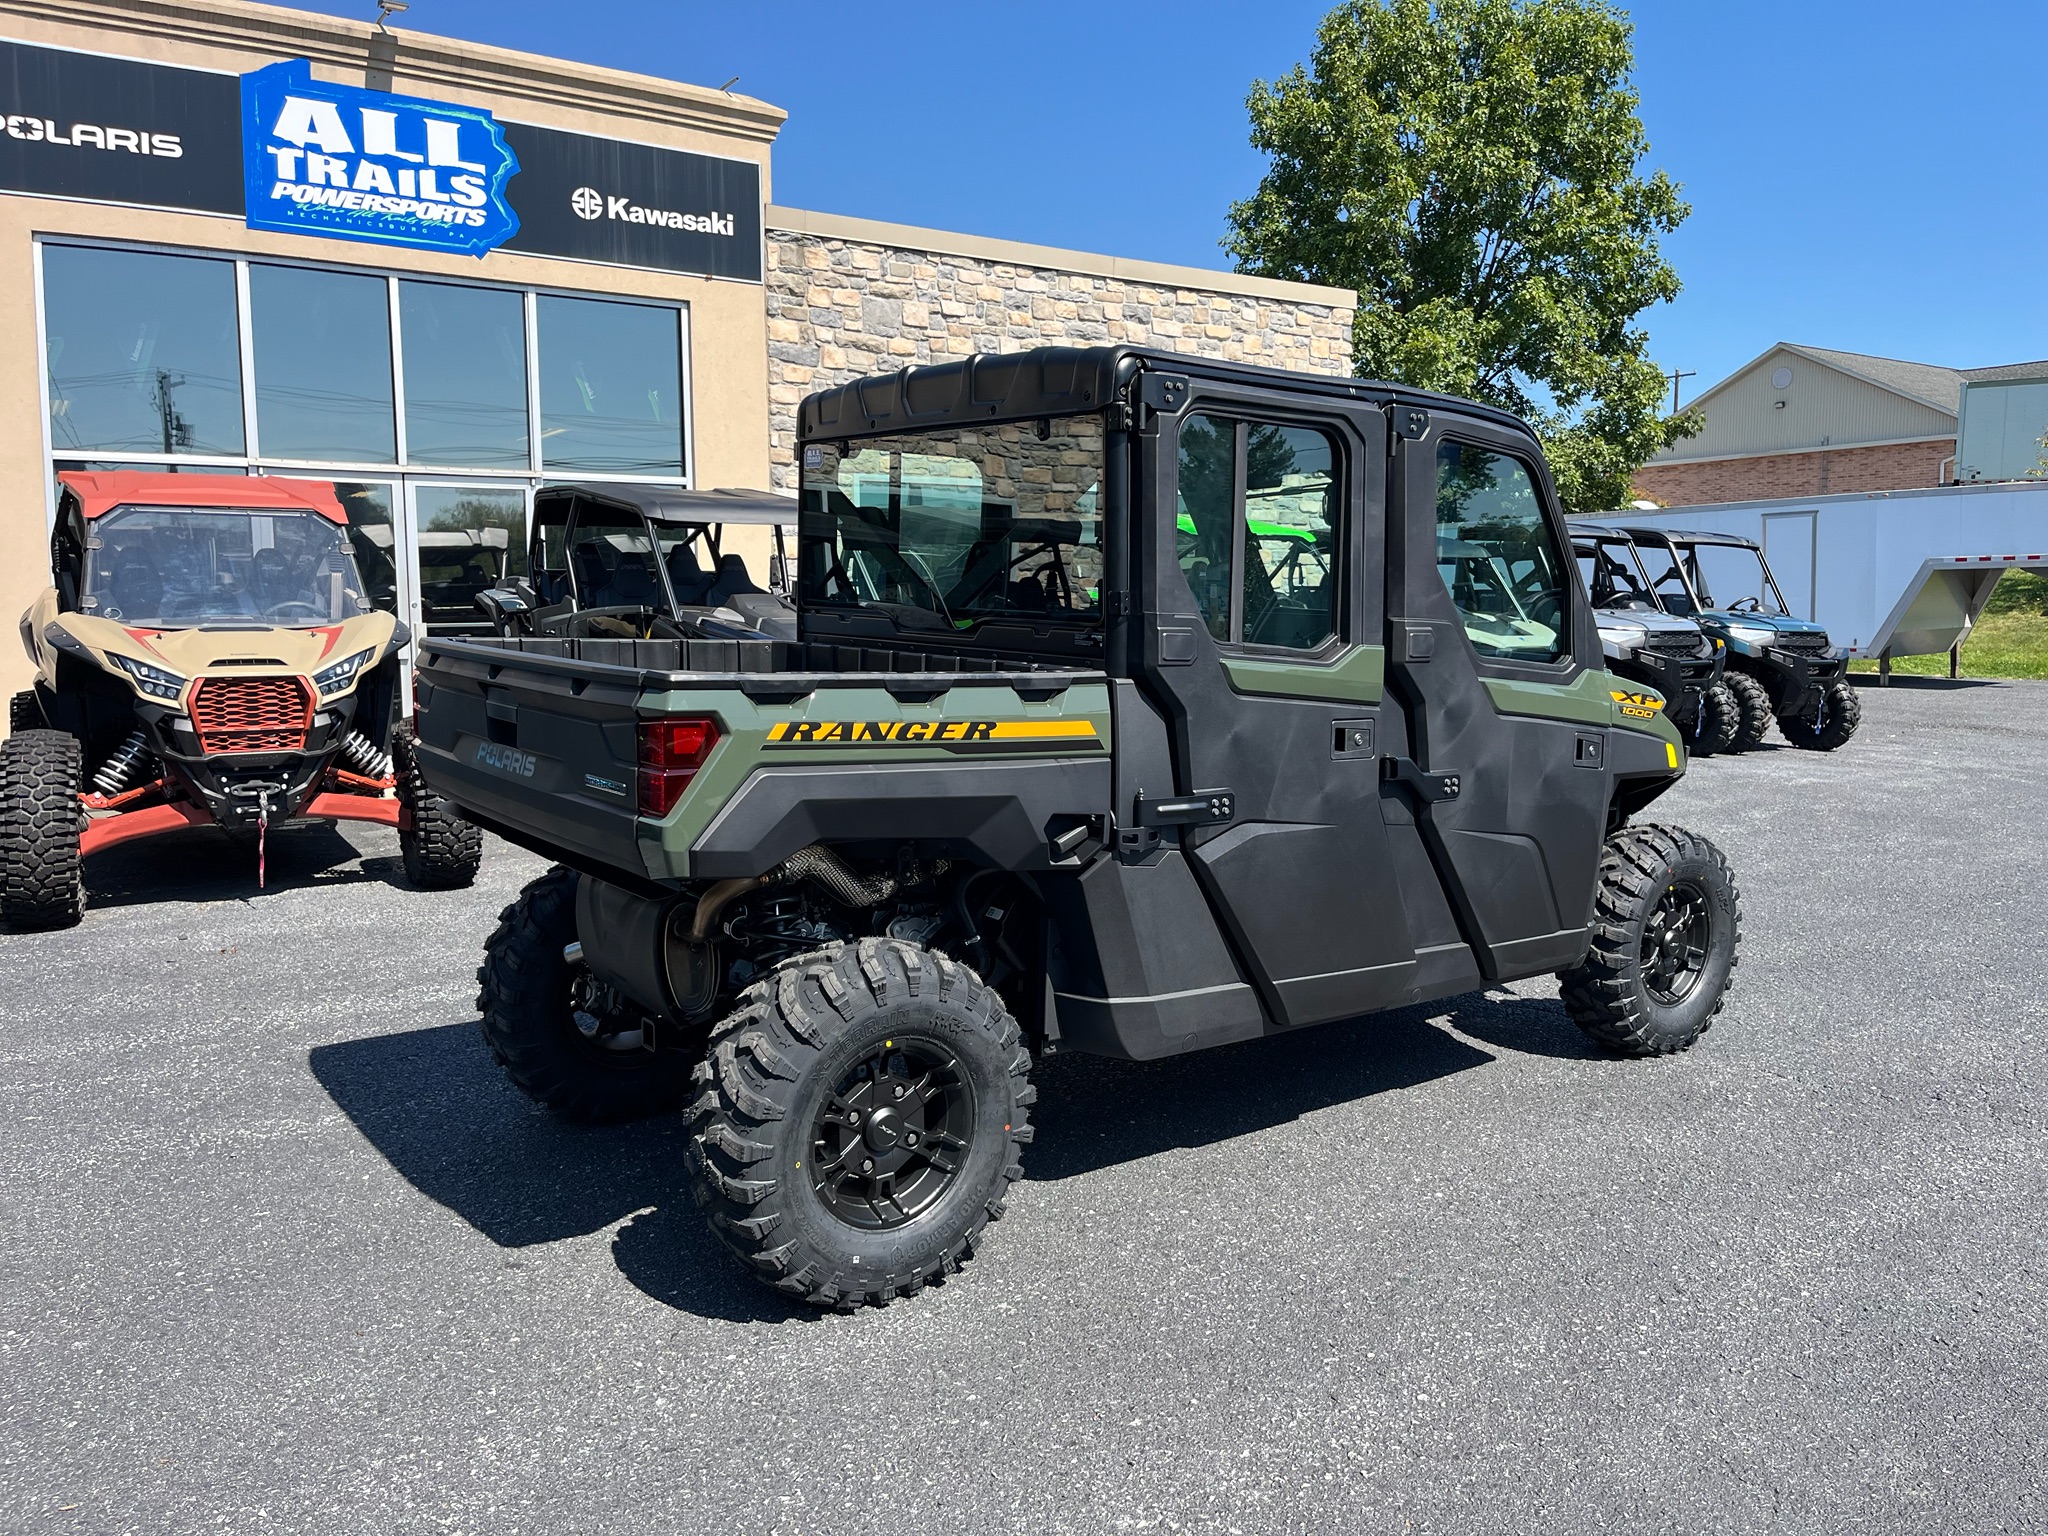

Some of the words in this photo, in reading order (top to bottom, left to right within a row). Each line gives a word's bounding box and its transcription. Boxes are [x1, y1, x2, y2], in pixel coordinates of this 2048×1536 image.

[0, 114, 183, 158] OLARIS
[272, 95, 486, 176] ALL
[266, 144, 488, 207] TRAILS
[270, 181, 488, 227] POWERSPORTS
[607, 195, 734, 237] Kawasaki
[449, 231, 464, 239] PA
[1618, 689, 1659, 705] XP
[1622, 706, 1654, 719] 1000
[778, 720, 997, 742] RANGER
[477, 741, 537, 778] POLARIS
